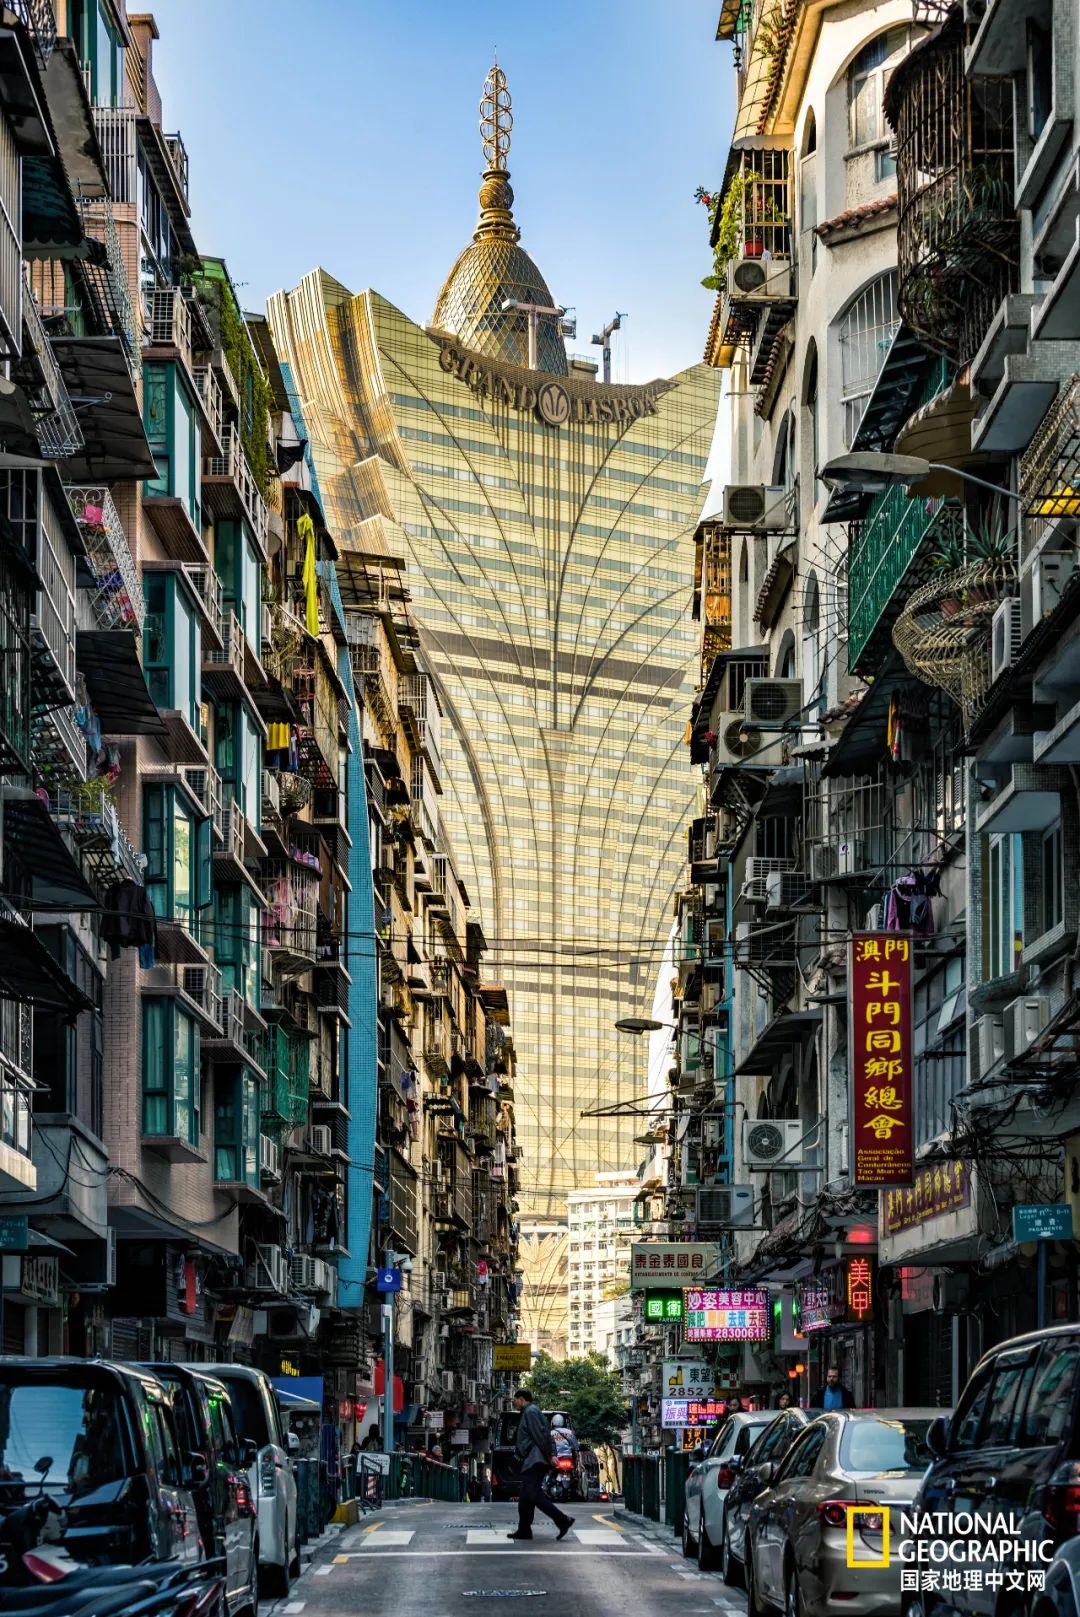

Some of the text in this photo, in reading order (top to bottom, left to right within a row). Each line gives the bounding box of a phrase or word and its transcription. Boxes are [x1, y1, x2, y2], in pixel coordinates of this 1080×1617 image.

[439, 349, 660, 423] GRAND LISBOA
[856, 939, 909, 962] 澳門
[687, 1291, 767, 1310] 妙姿美容中心
[850, 1258, 870, 1319] 美甲
